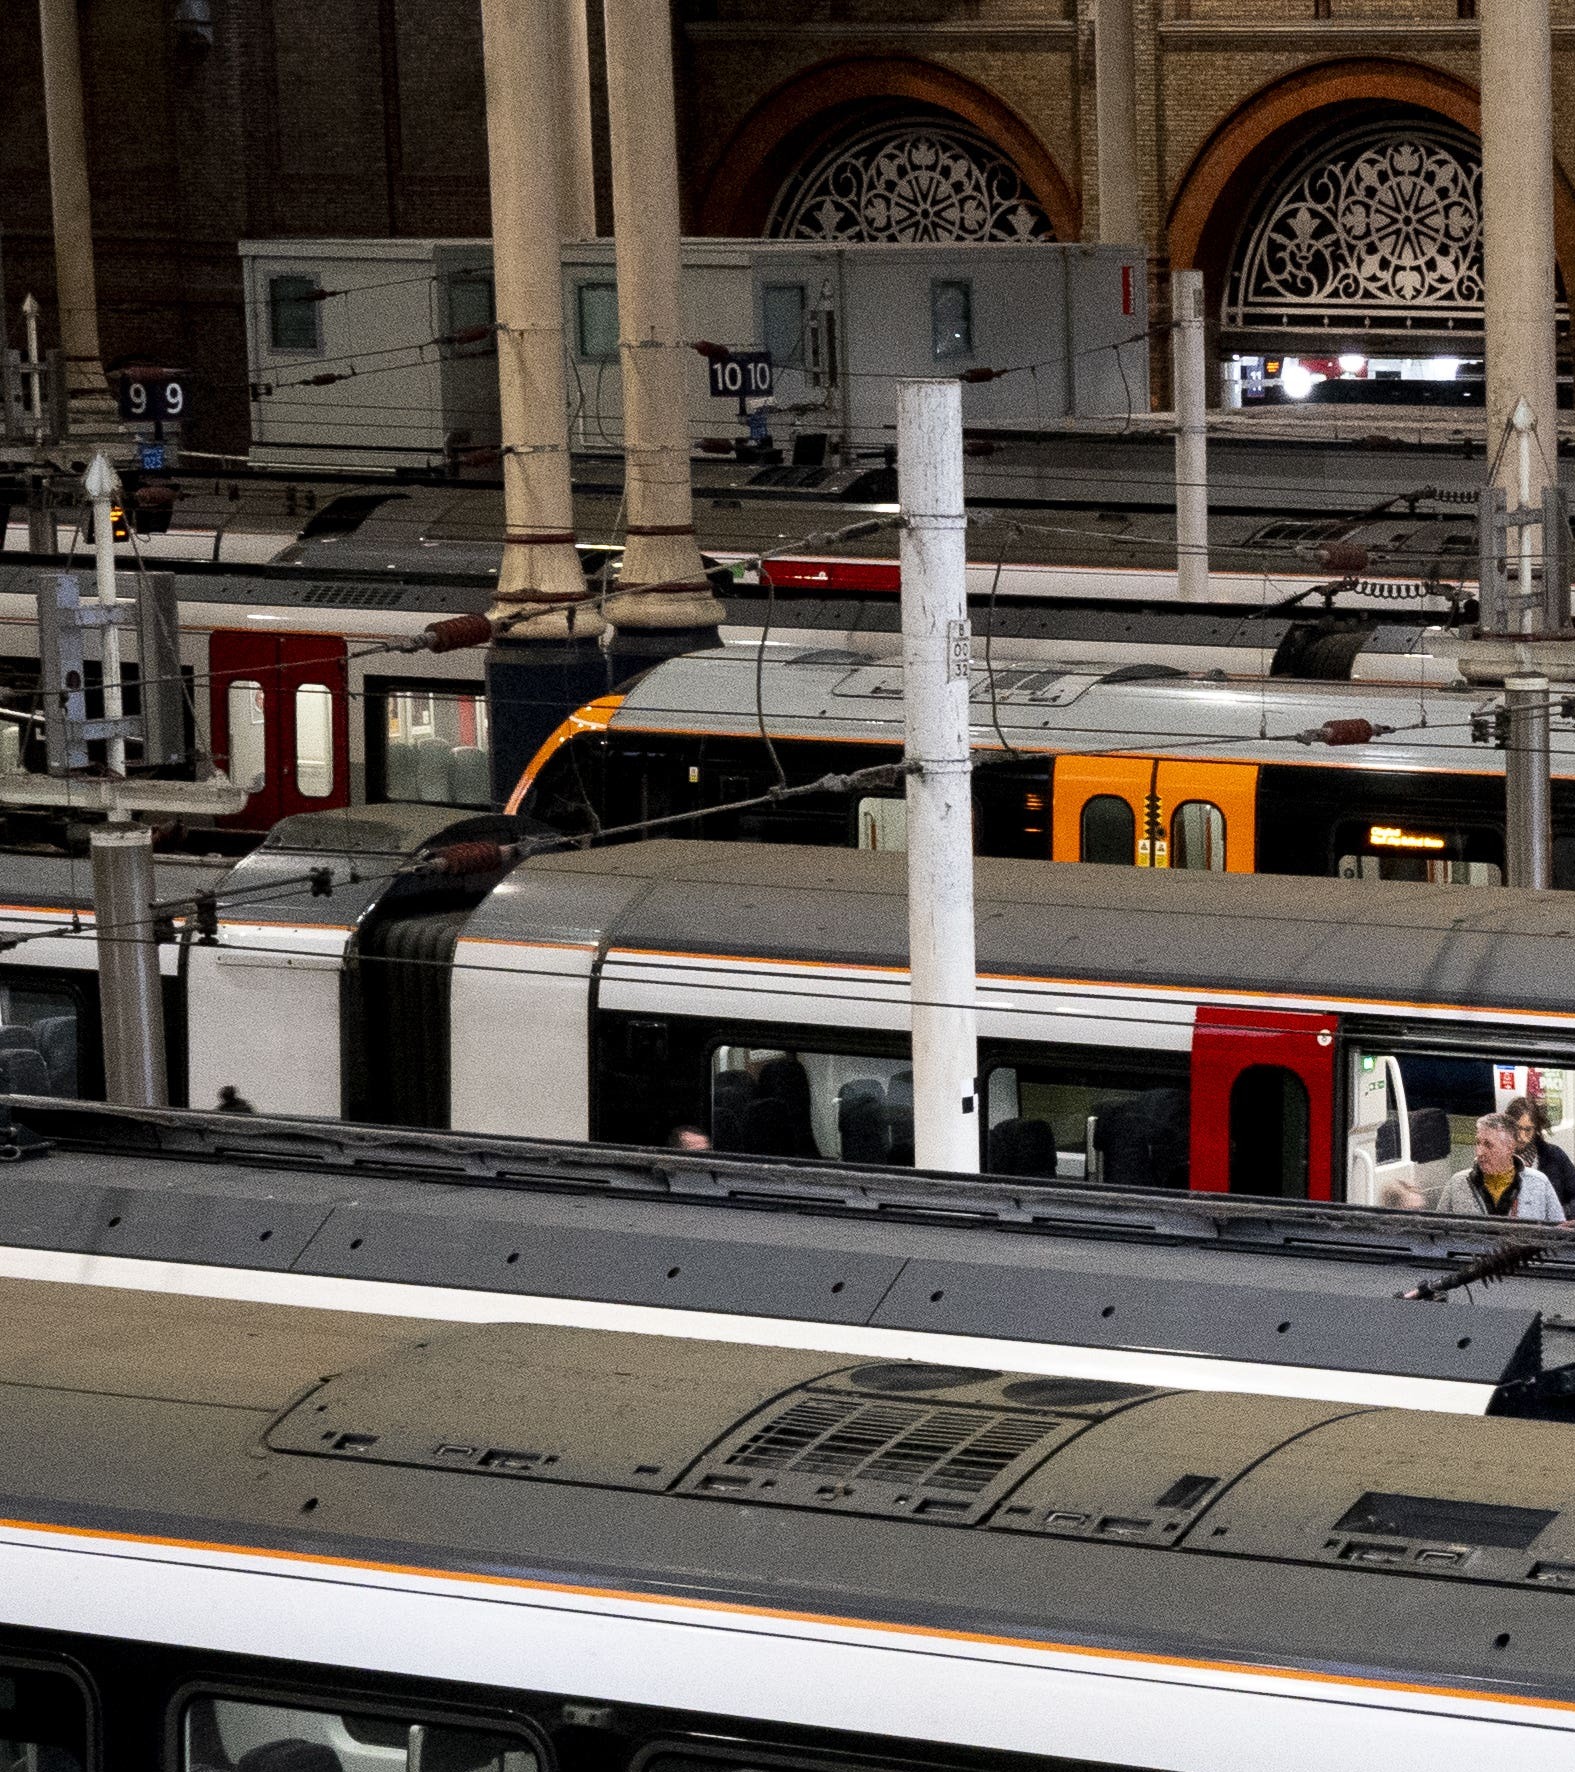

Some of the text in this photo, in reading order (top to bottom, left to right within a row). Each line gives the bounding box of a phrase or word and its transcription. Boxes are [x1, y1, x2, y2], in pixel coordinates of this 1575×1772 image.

[713, 362, 742, 391] 10
[747, 362, 770, 390] 10
[130, 383, 147, 414] 9
[166, 383, 183, 414] 9
